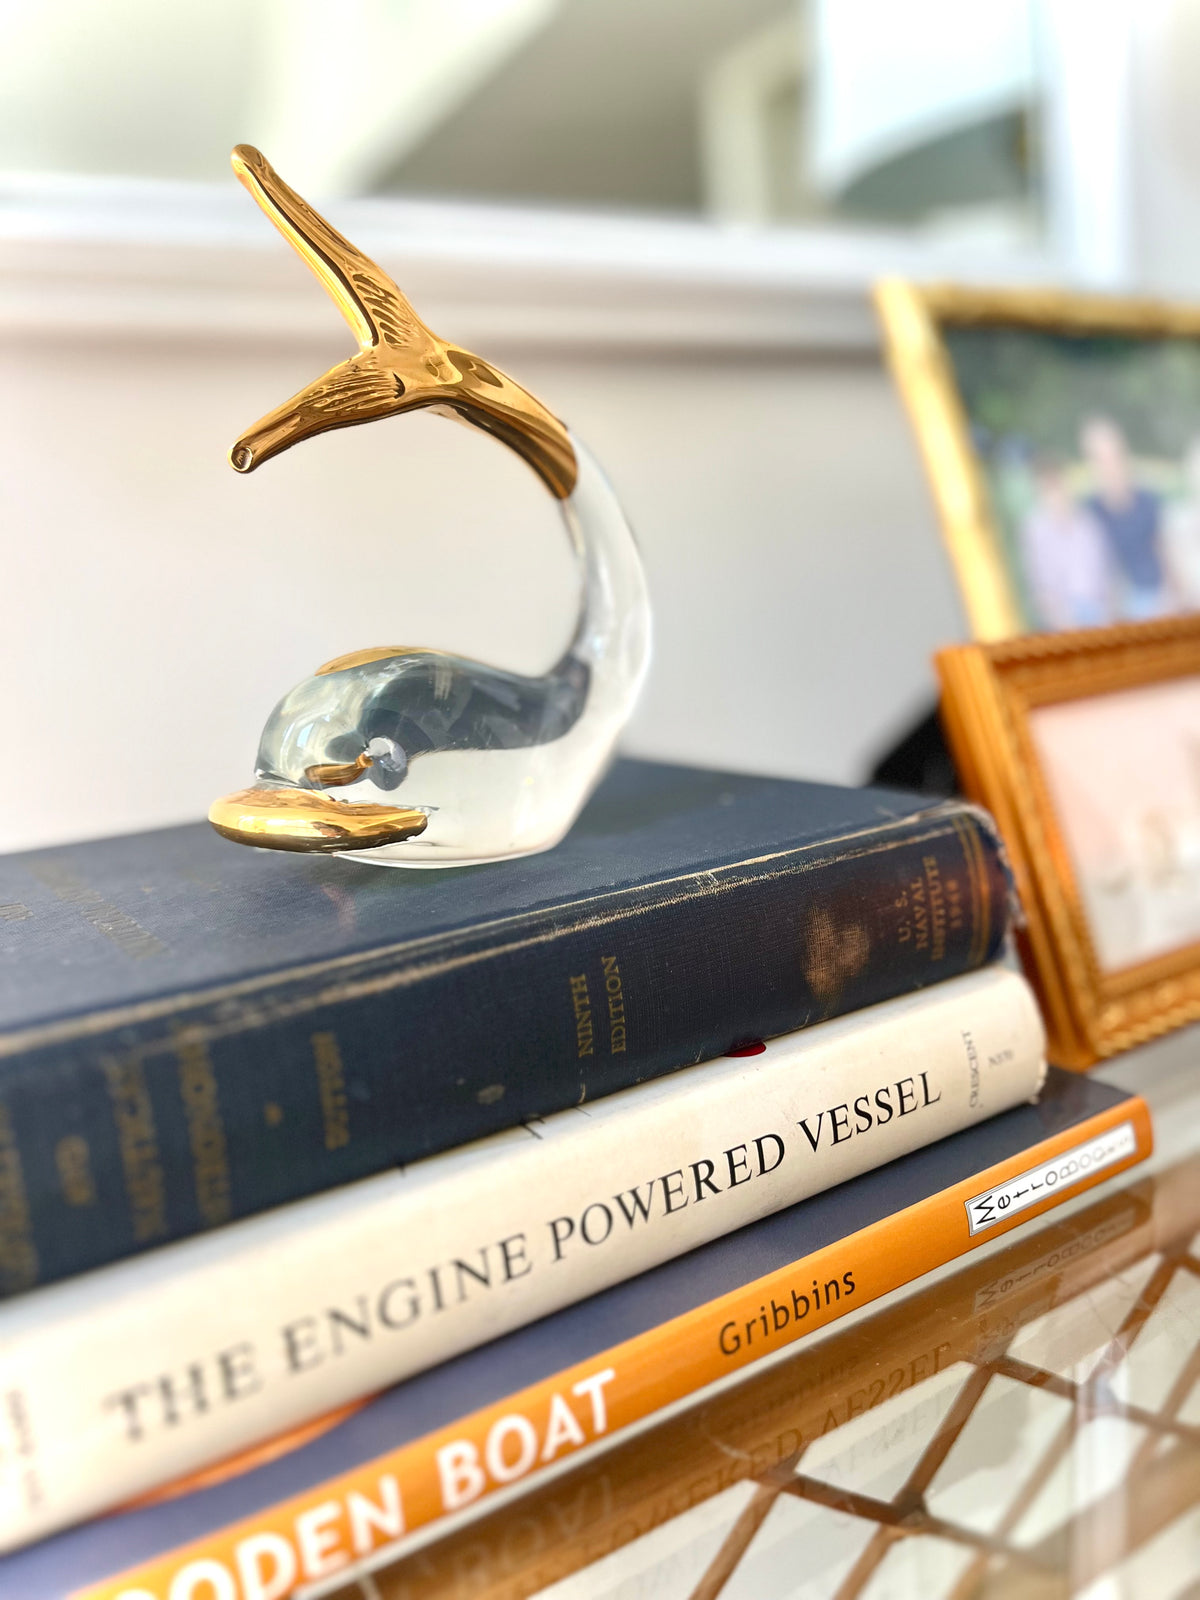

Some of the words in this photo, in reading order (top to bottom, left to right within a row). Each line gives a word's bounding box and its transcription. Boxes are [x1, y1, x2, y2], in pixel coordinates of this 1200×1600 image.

[911, 876, 929, 950] NAVAL
[569, 973, 594, 1059] NINTH
[600, 955, 627, 1055] EDITION
[960, 1029, 982, 1109] CRESCENT
[101, 1341, 263, 1443] THE
[279, 1232, 534, 1376] ENGINE
[547, 1132, 786, 1265] POWERED
[797, 1070, 942, 1154] VESSEL
[717, 1269, 857, 1357] Gribbins
[435, 1369, 616, 1510] BOAT
